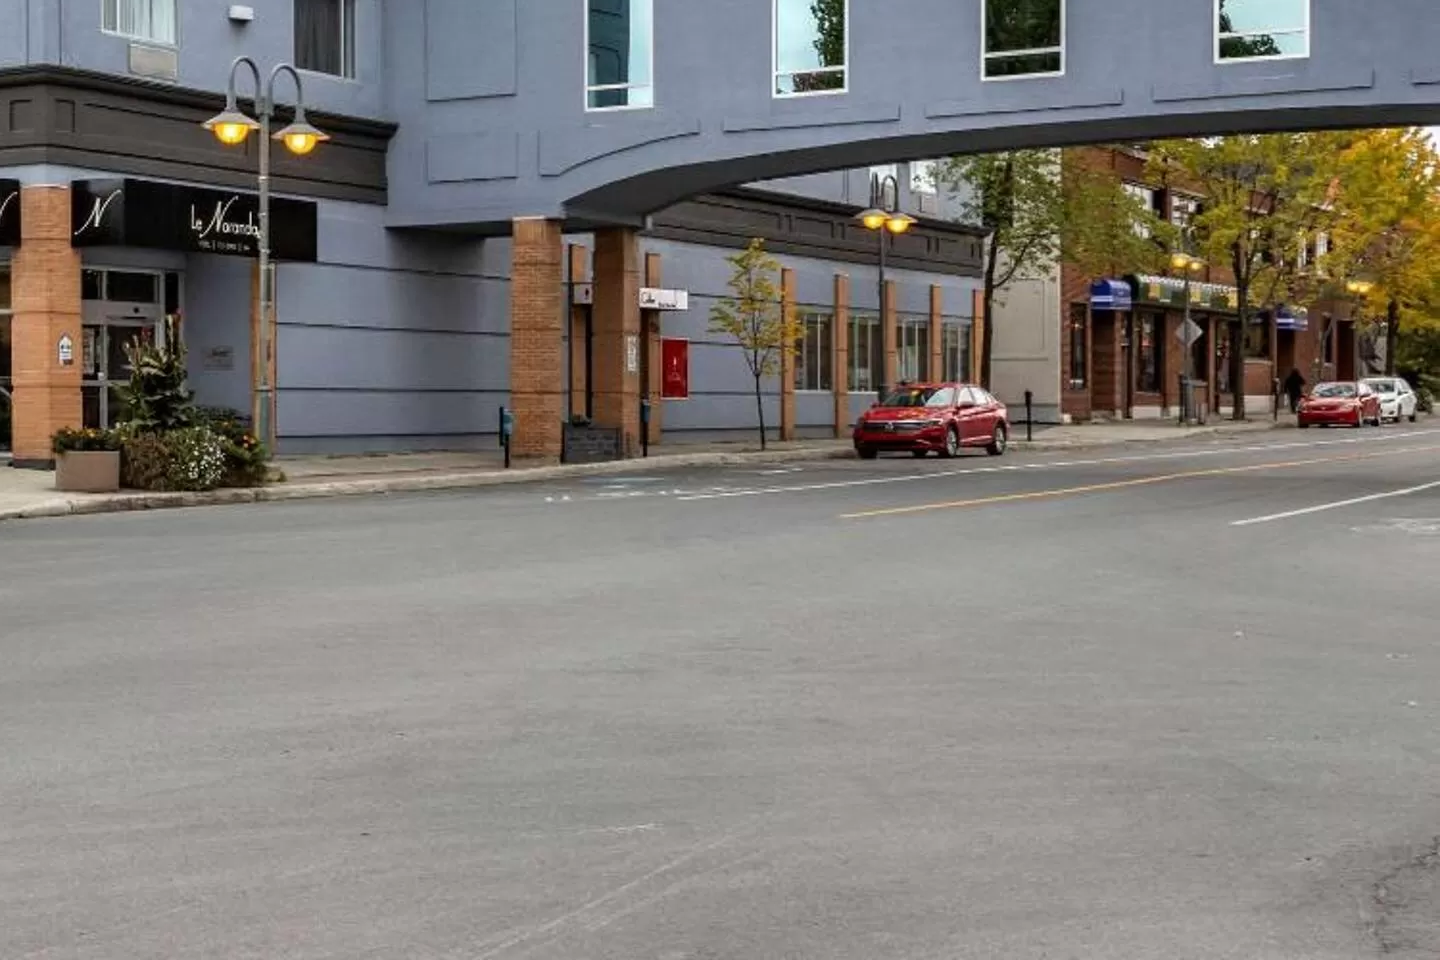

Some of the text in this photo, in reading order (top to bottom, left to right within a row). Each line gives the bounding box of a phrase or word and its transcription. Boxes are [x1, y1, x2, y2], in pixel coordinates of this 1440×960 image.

[74, 189, 122, 235] N
[191, 195, 260, 238] Le Noranda
